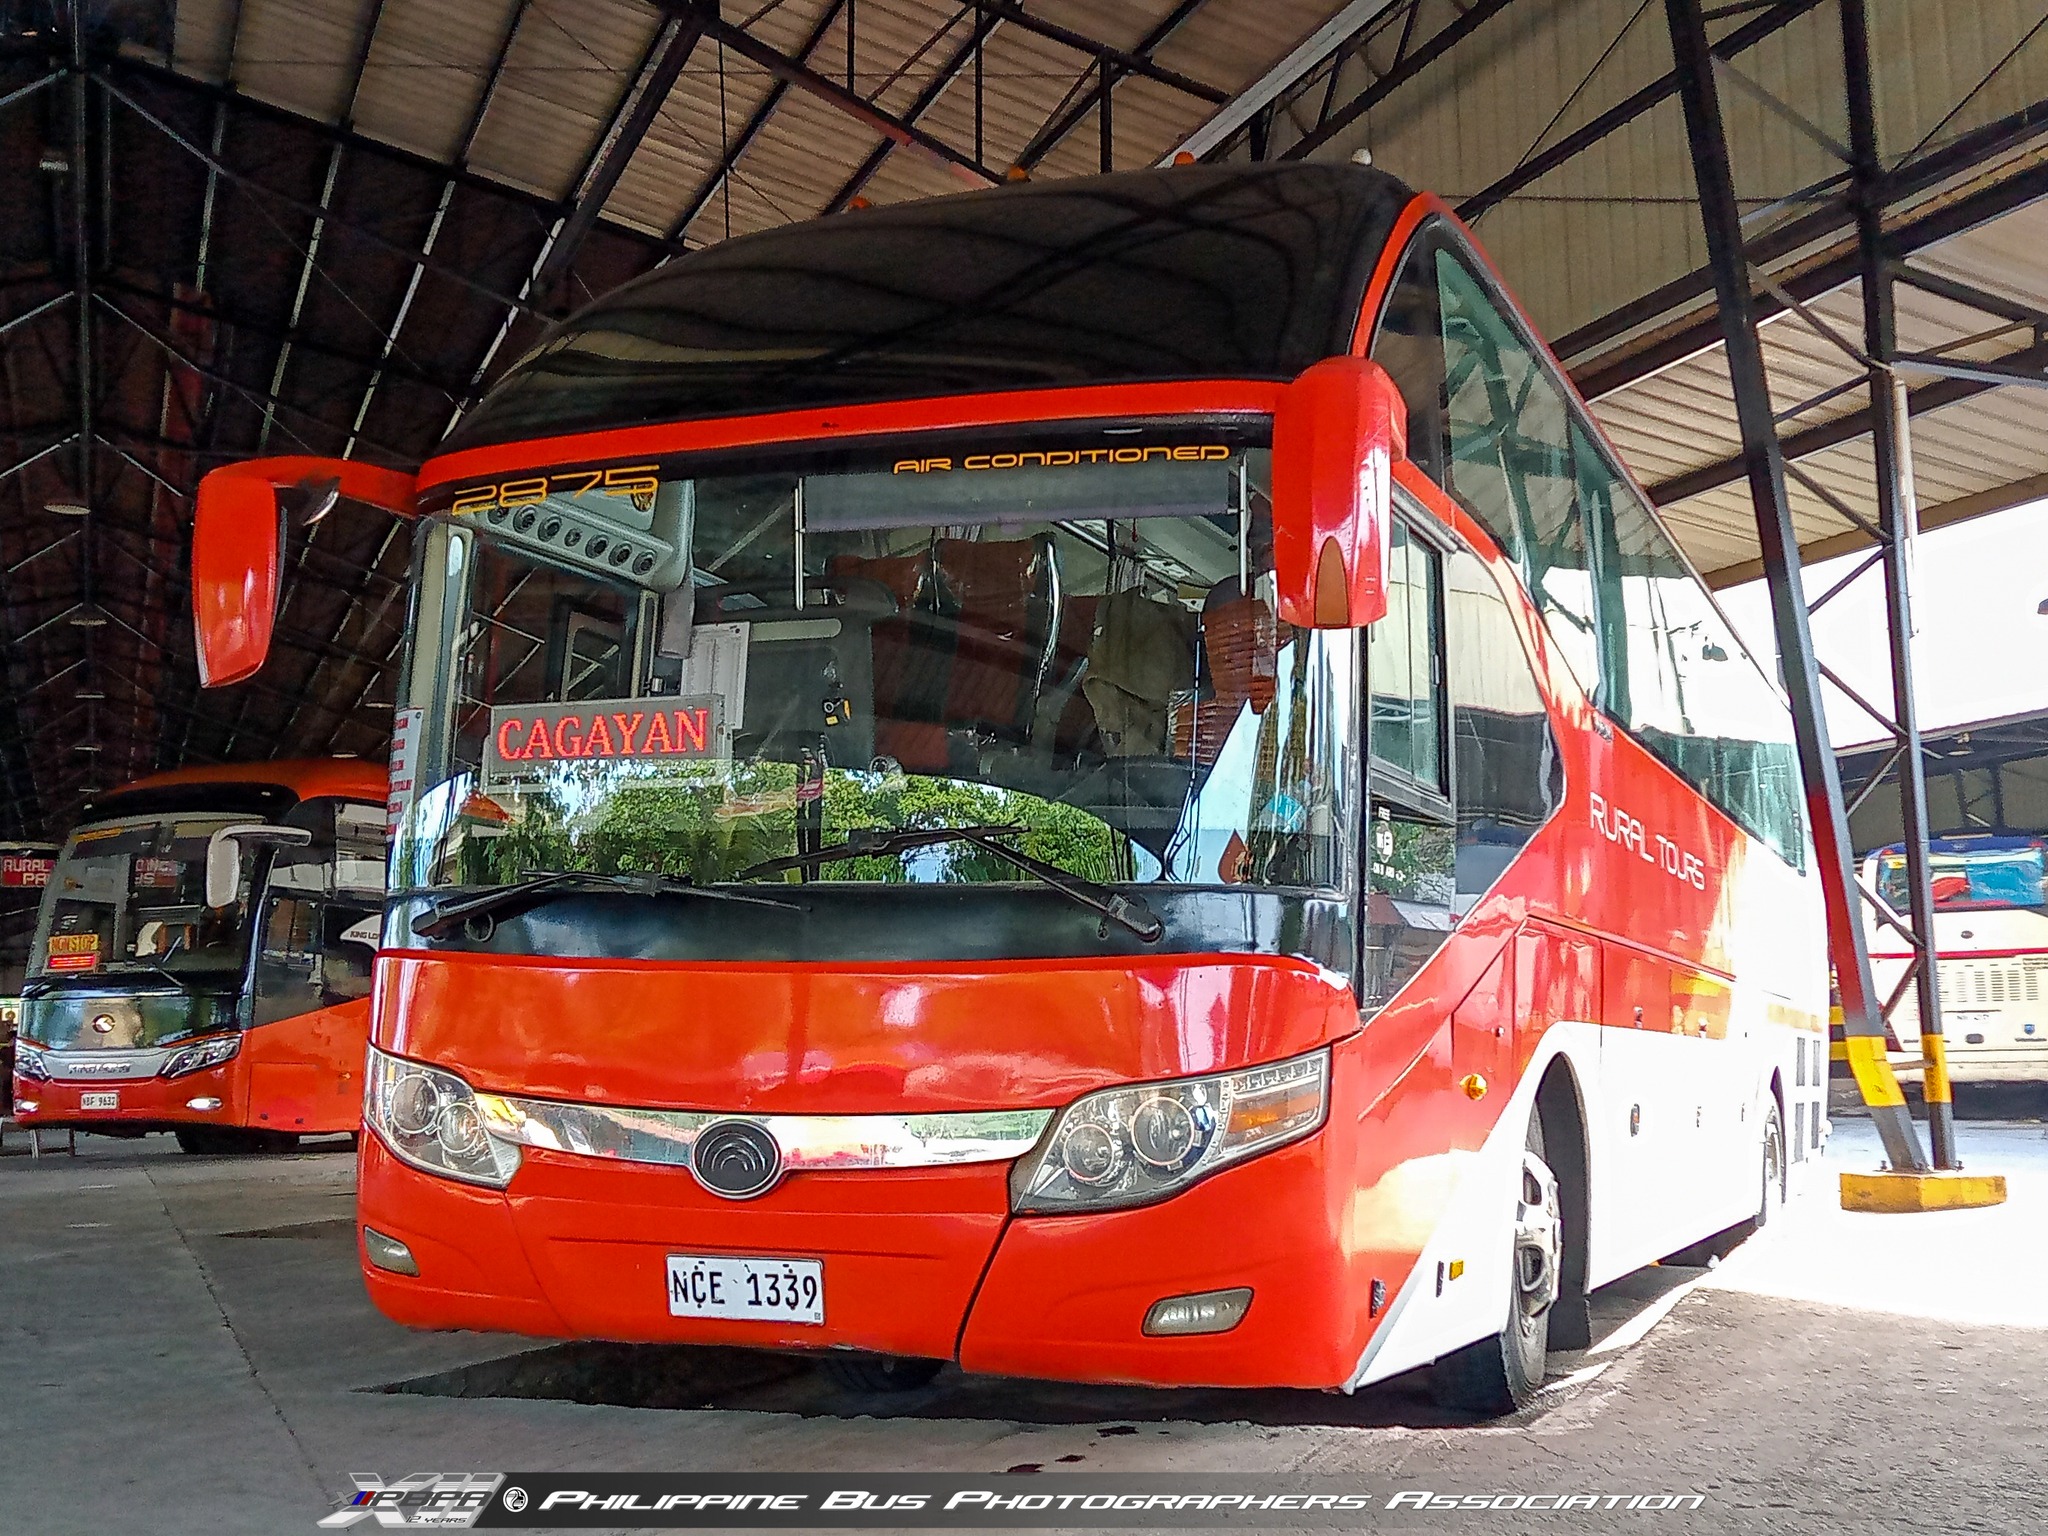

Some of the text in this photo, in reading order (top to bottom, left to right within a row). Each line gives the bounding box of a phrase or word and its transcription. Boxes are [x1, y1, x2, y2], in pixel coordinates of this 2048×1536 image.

[893, 445, 1229, 474] AIR CONDITIONED
[452, 464, 660, 516] 2875
[497, 707, 709, 761] CAGAYAN
[1589, 791, 1705, 891] RURAL TOURS
[672, 1270, 818, 1309] NCE 1339
